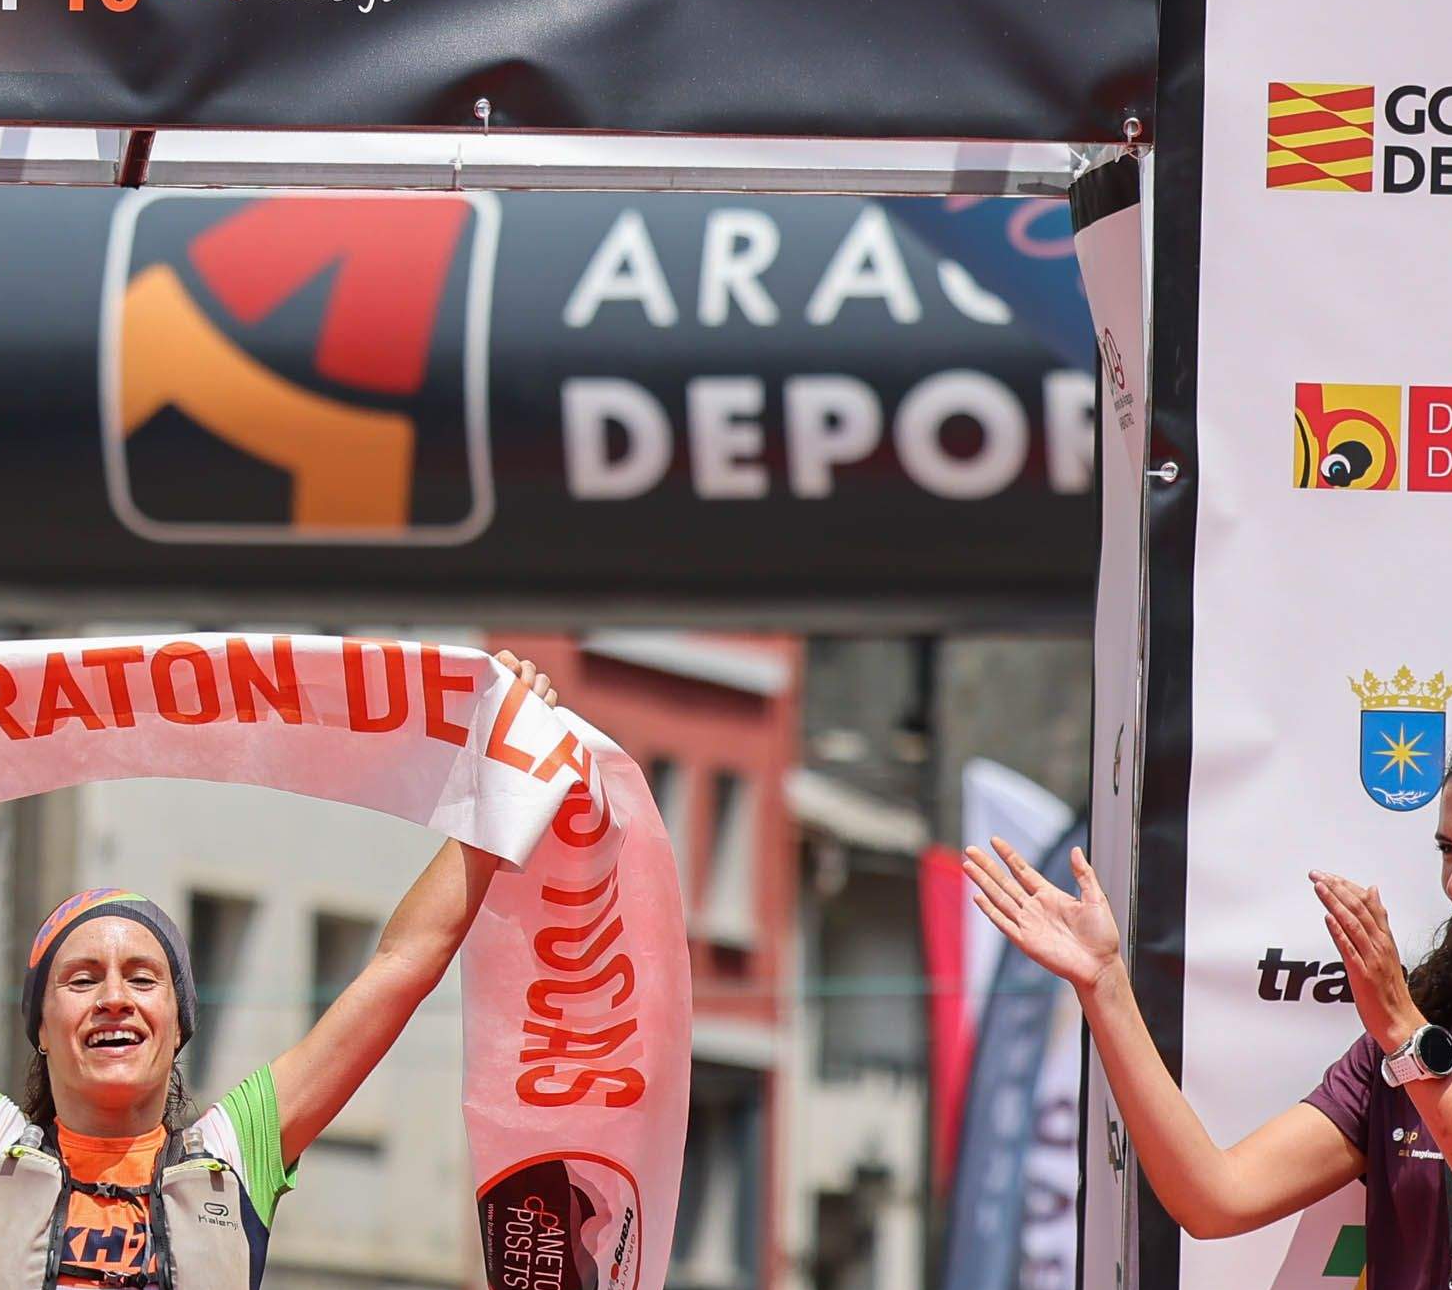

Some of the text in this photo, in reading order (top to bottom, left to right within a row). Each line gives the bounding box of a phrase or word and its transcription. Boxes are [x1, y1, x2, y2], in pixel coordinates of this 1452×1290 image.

[561, 369, 1094, 502] DEPOR
[341, 636, 475, 749] DE
[503, 1206, 534, 1290] POSETS
